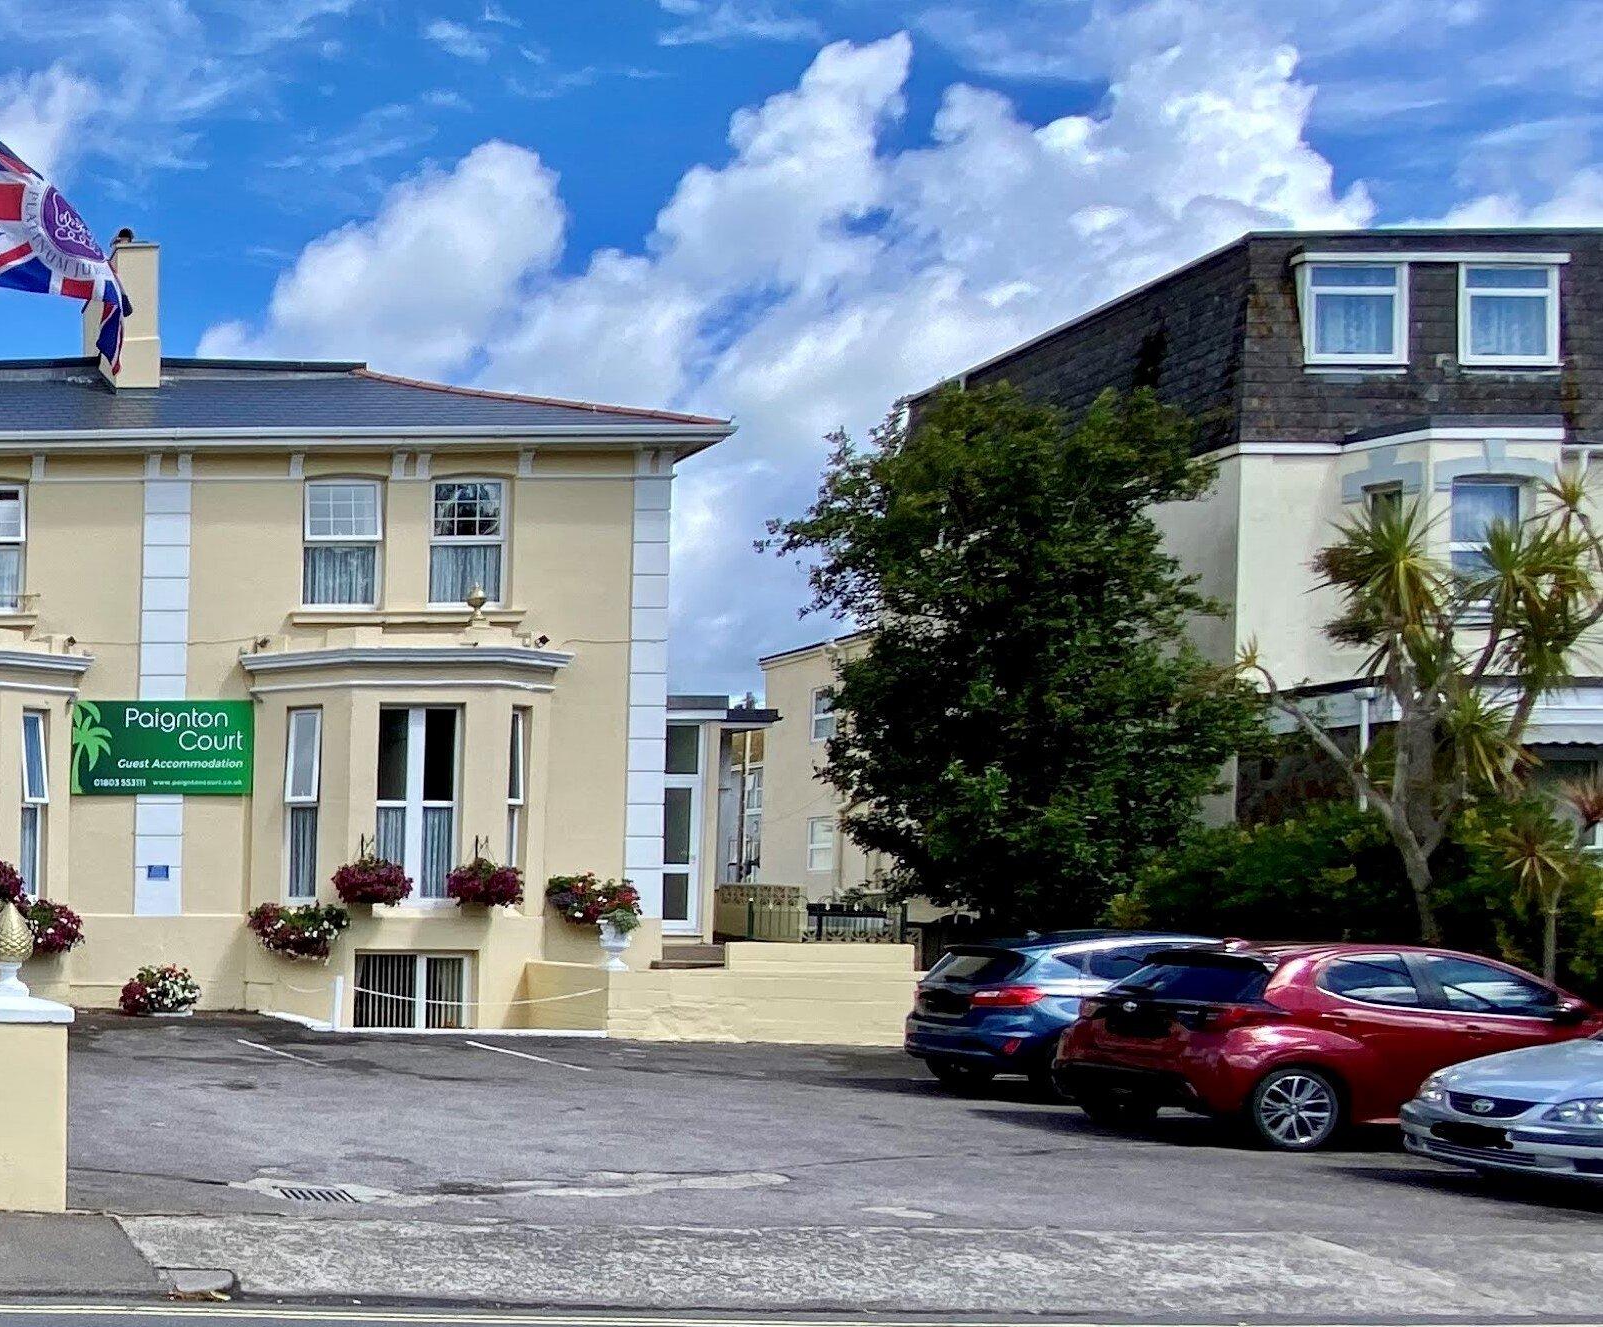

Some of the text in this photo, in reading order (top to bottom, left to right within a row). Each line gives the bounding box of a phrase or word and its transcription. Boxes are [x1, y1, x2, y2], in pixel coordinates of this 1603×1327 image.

[125, 707, 229, 732] Paignton
[178, 730, 244, 751] Court
[117, 757, 244, 769] Guest Accommodation
[93, 778, 120, 787] 01803
